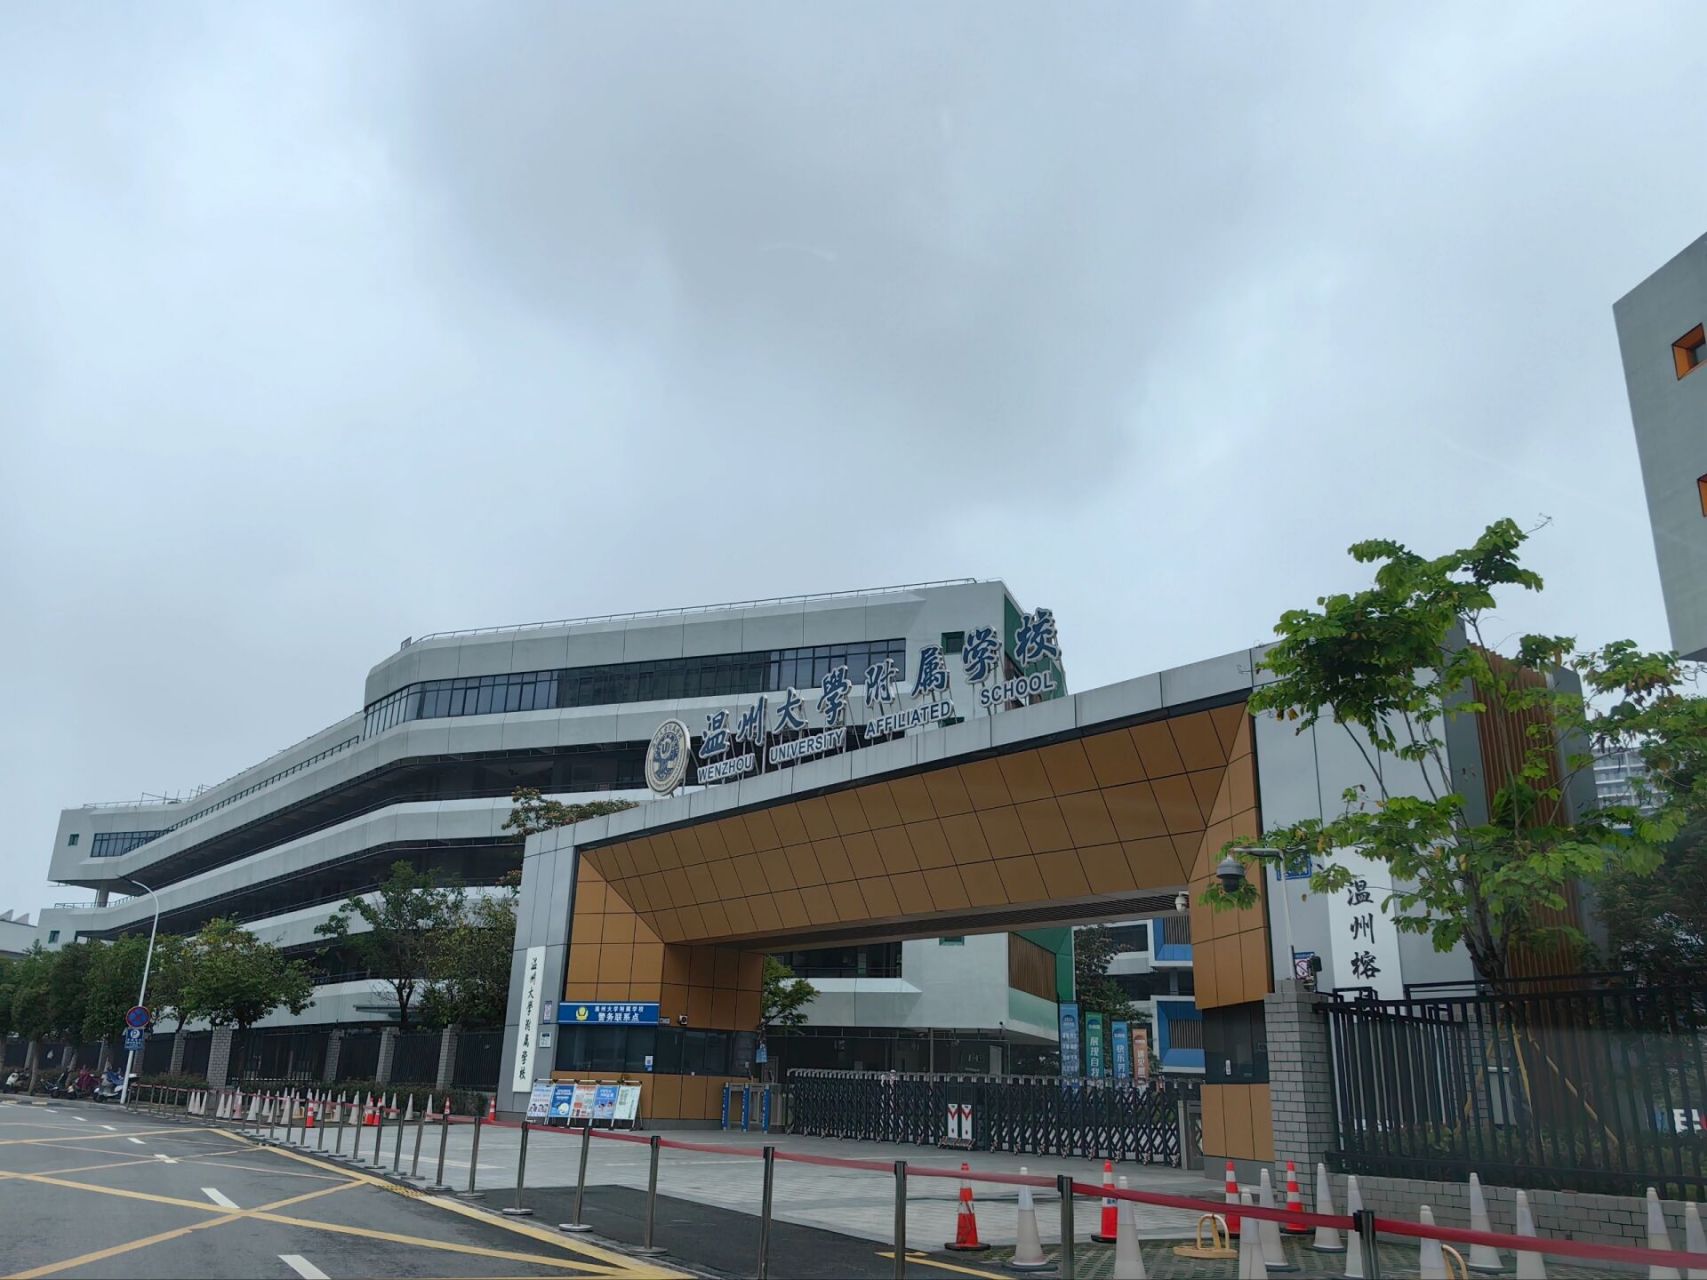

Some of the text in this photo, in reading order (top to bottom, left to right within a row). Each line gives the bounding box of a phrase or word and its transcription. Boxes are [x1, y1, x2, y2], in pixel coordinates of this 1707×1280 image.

[698, 755, 754, 783] WENZHOU
[769, 729, 845, 763] UNIVERSITY
[865, 701, 953, 738] AFFILIATED
[980, 672, 1056, 706] SCHOOL
